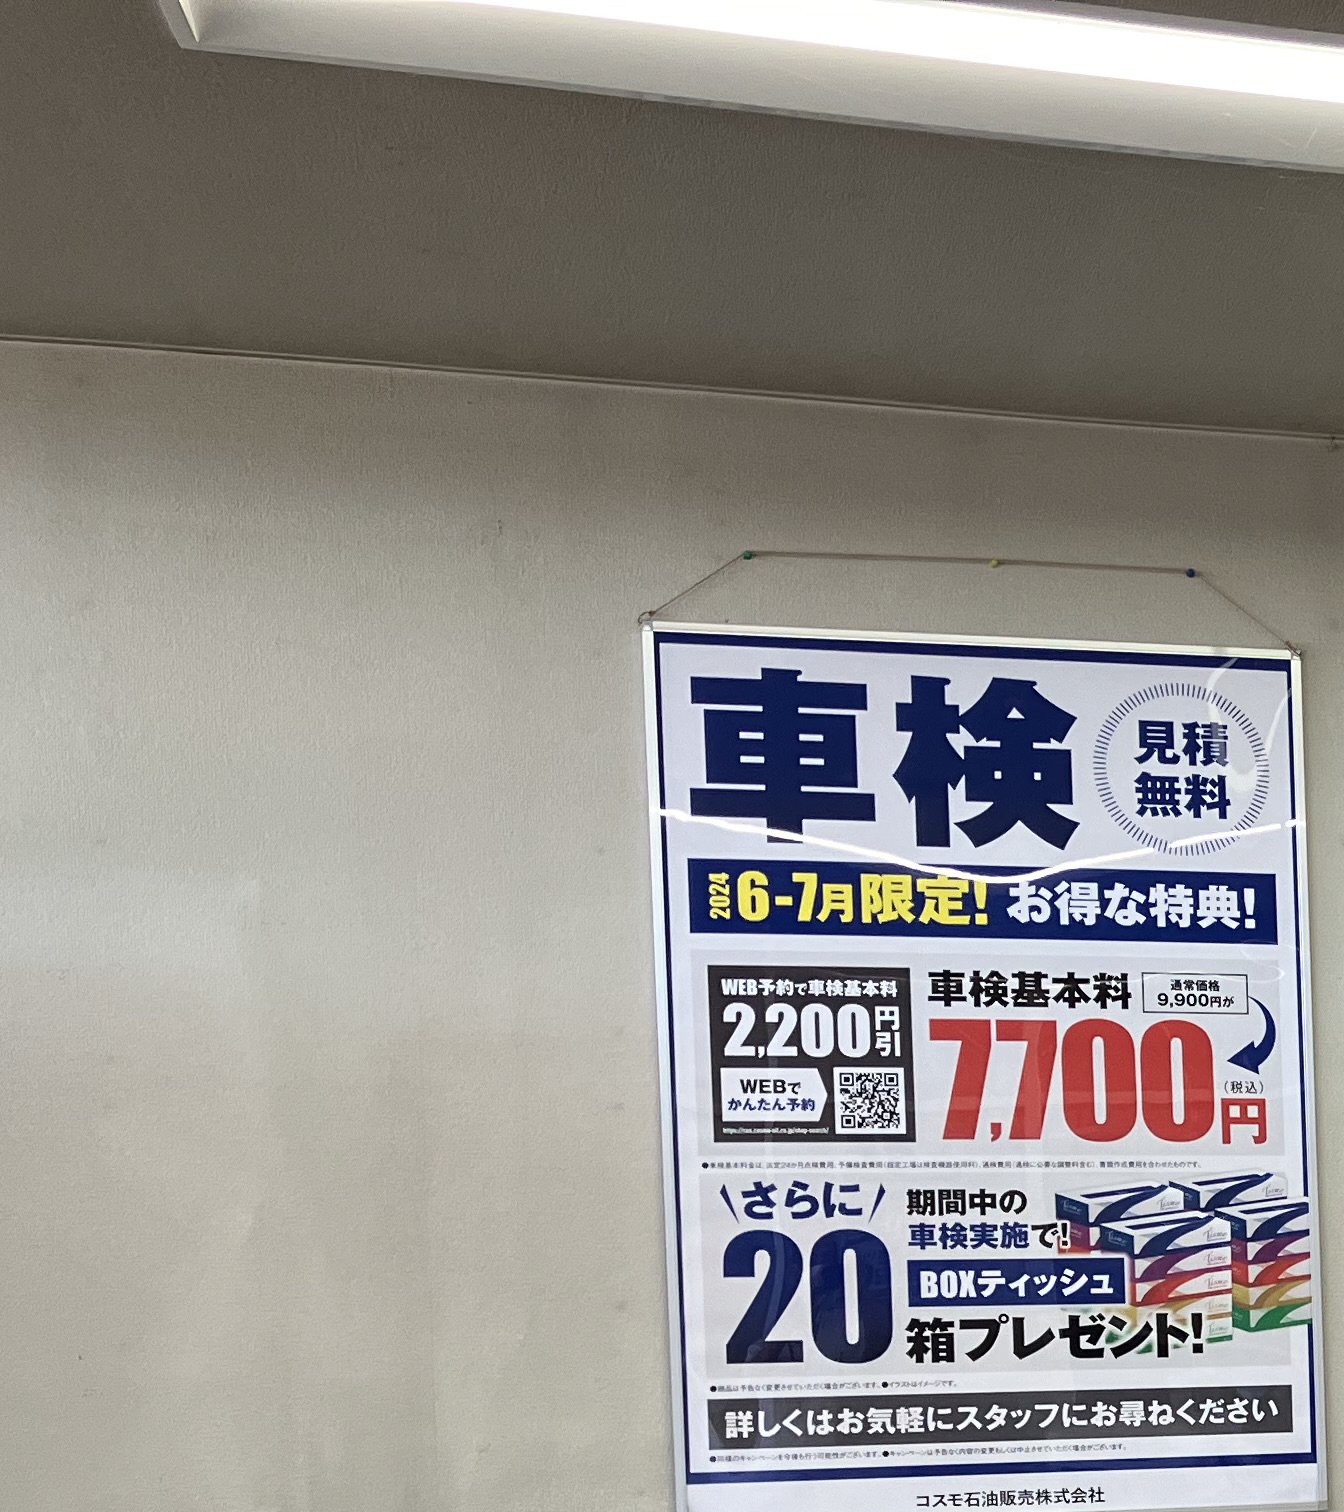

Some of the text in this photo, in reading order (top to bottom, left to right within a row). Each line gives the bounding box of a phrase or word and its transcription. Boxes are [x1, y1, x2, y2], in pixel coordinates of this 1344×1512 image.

[689, 667, 1080, 850] 車検
[1135, 719, 1229, 766] 見積
[1135, 773, 1231, 820] 無料
[709, 870, 1257, 929] 2024 6-7月限定! お得な特典!
[721, 978, 898, 998] WEB予約で車検基本料
[928, 970, 1132, 1010] 車検基本料
[1156, 992, 1235, 1010] 9,900円が
[1170, 979, 1221, 993] 通常価格
[722, 1002, 871, 1059] 2,200
[740, 1078, 802, 1095] WEBで
[928, 1017, 1269, 1146] 7,700 円
[1223, 1080, 1265, 1096] (税込)
[727, 1098, 816, 1112] かんたん予約
[742, 1180, 864, 1219] さらに
[907, 1189, 1027, 1216] 期間中の
[908, 1221, 1071, 1250] 車検実施で!
[722, 1229, 893, 1365] 20
[920, 1269, 1114, 1300] BOXティッシュ
[906, 1311, 1205, 1363] 箱プレゼント!
[725, 1397, 1279, 1439] 詳しくはお気軽にスタッフにお尋ねください
[916, 1487, 1106, 1508] コスモ石油販売株式会社
